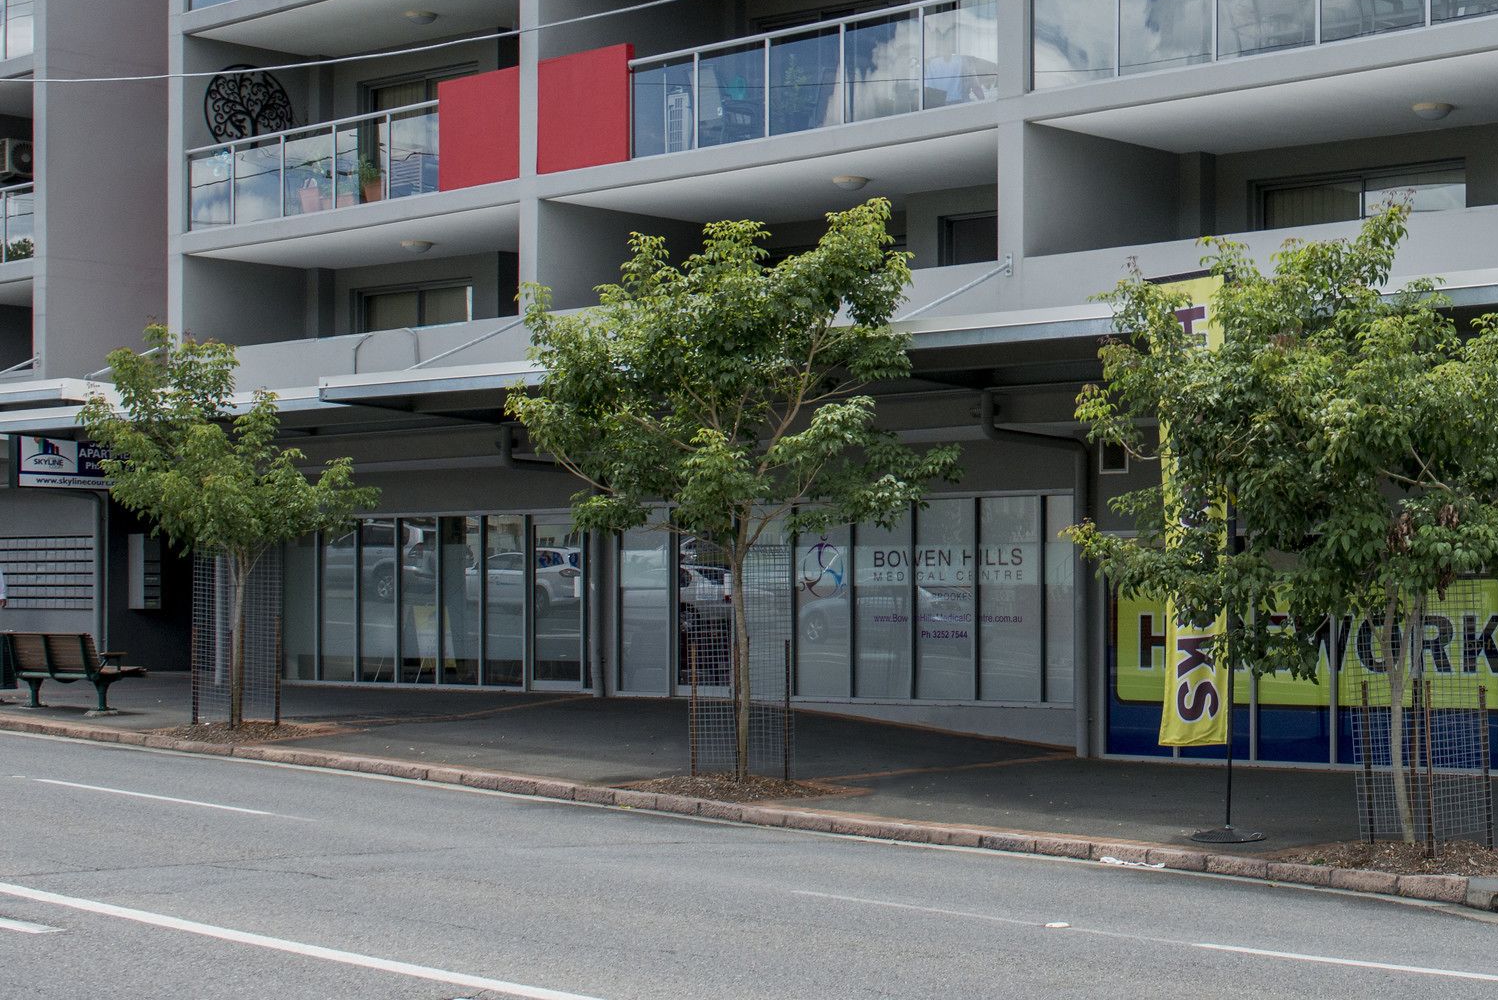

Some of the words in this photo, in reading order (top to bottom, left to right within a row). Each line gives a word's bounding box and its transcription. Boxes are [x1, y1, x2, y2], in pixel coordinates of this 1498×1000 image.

[34, 458, 63, 467] SKYLINE
[874, 549, 951, 568] BOWEN
[963, 548, 1023, 566] HILLS
[873, 571, 945, 582] MEDCAL
[921, 630, 931, 638] Ph
[932, 630, 949, 639] 3252
[950, 630, 968, 639] 7544
